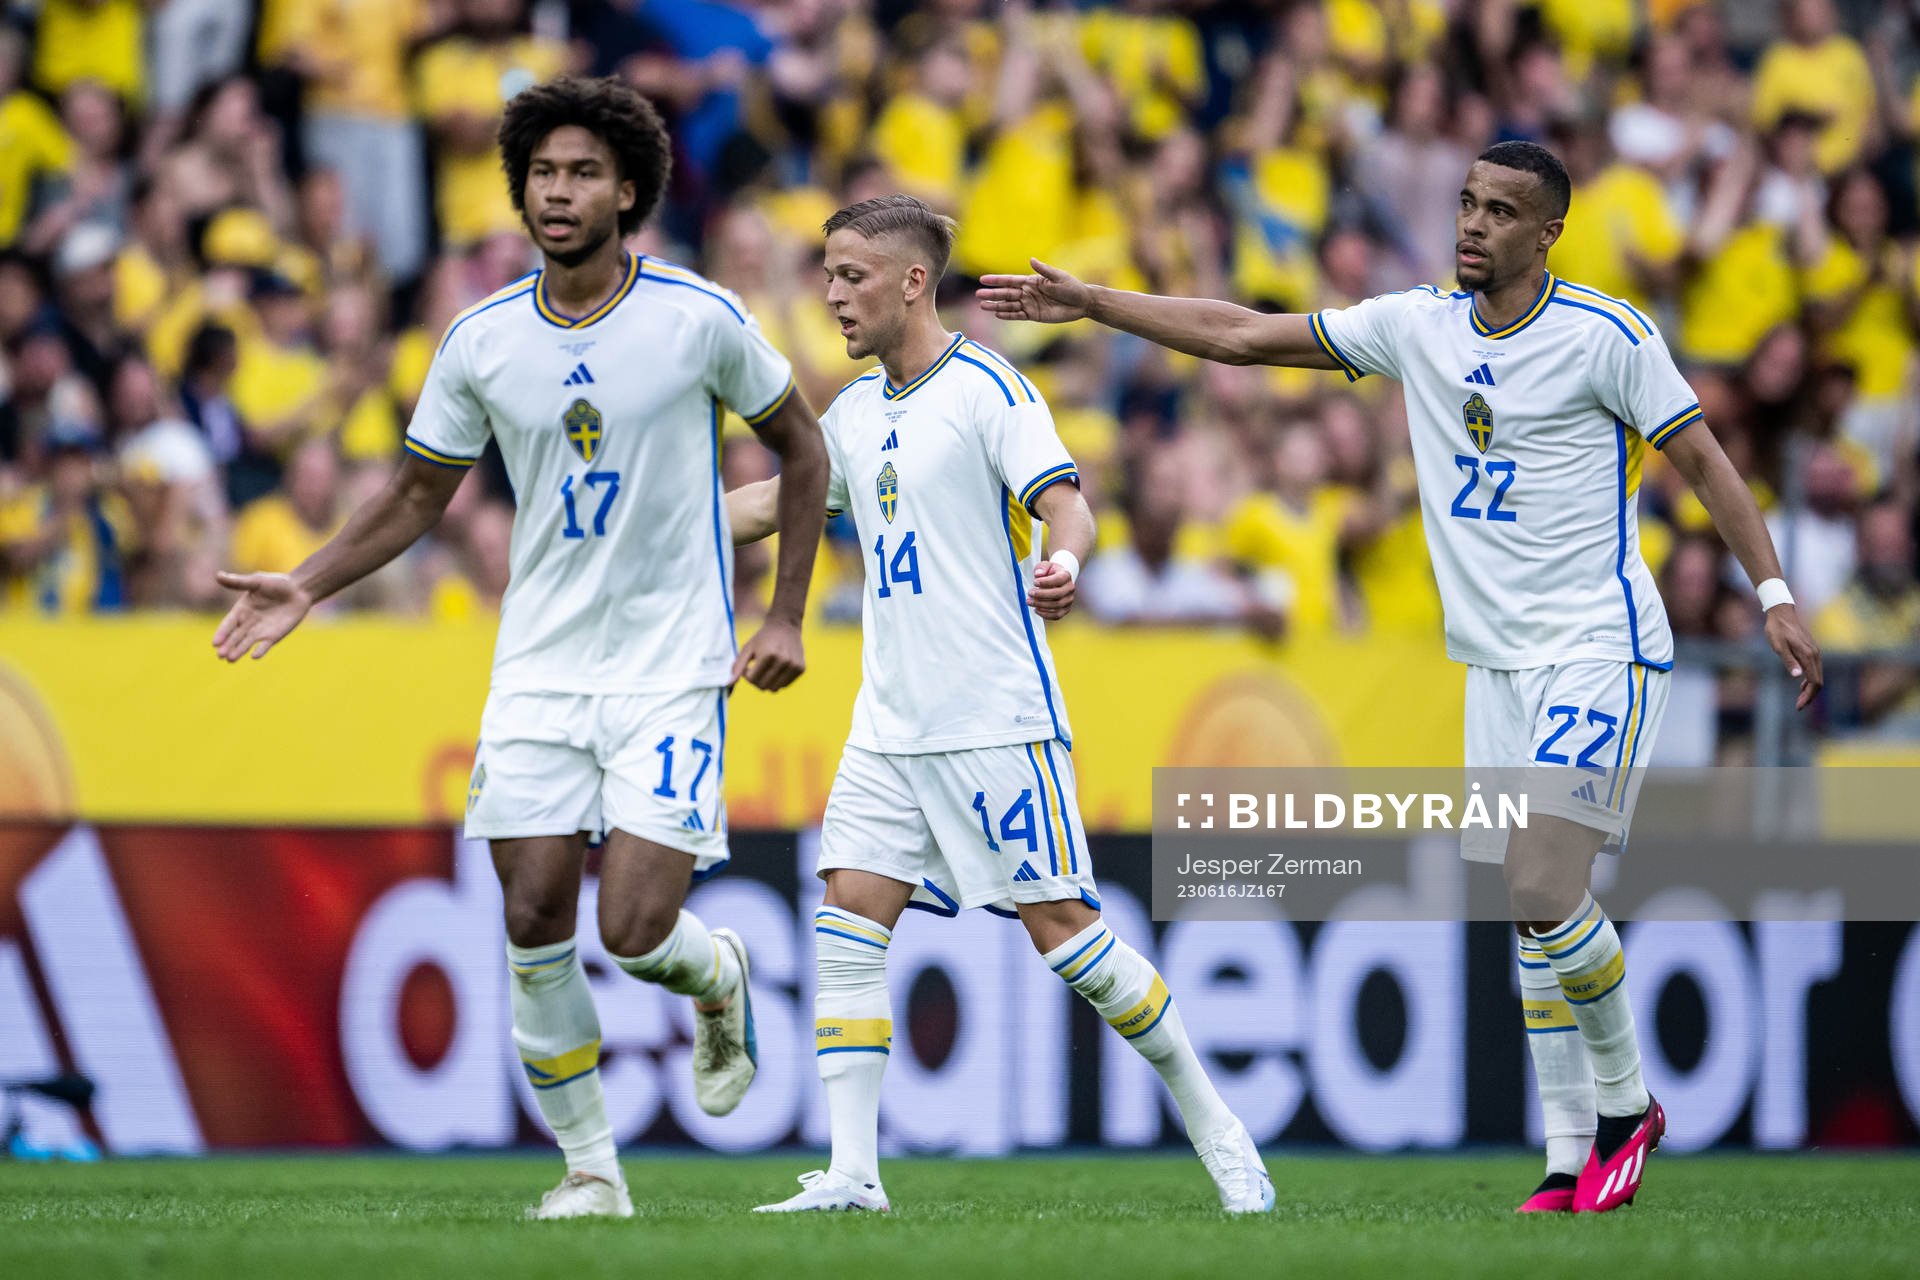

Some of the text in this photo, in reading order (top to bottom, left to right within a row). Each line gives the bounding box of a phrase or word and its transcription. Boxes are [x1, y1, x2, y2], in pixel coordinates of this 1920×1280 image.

[560, 470, 621, 540] 17
[1450, 454, 1518, 522] 22
[874, 531, 922, 598] 14
[652, 735, 713, 802] 17
[1534, 704, 1618, 770] 22
[972, 788, 1038, 853] 14
